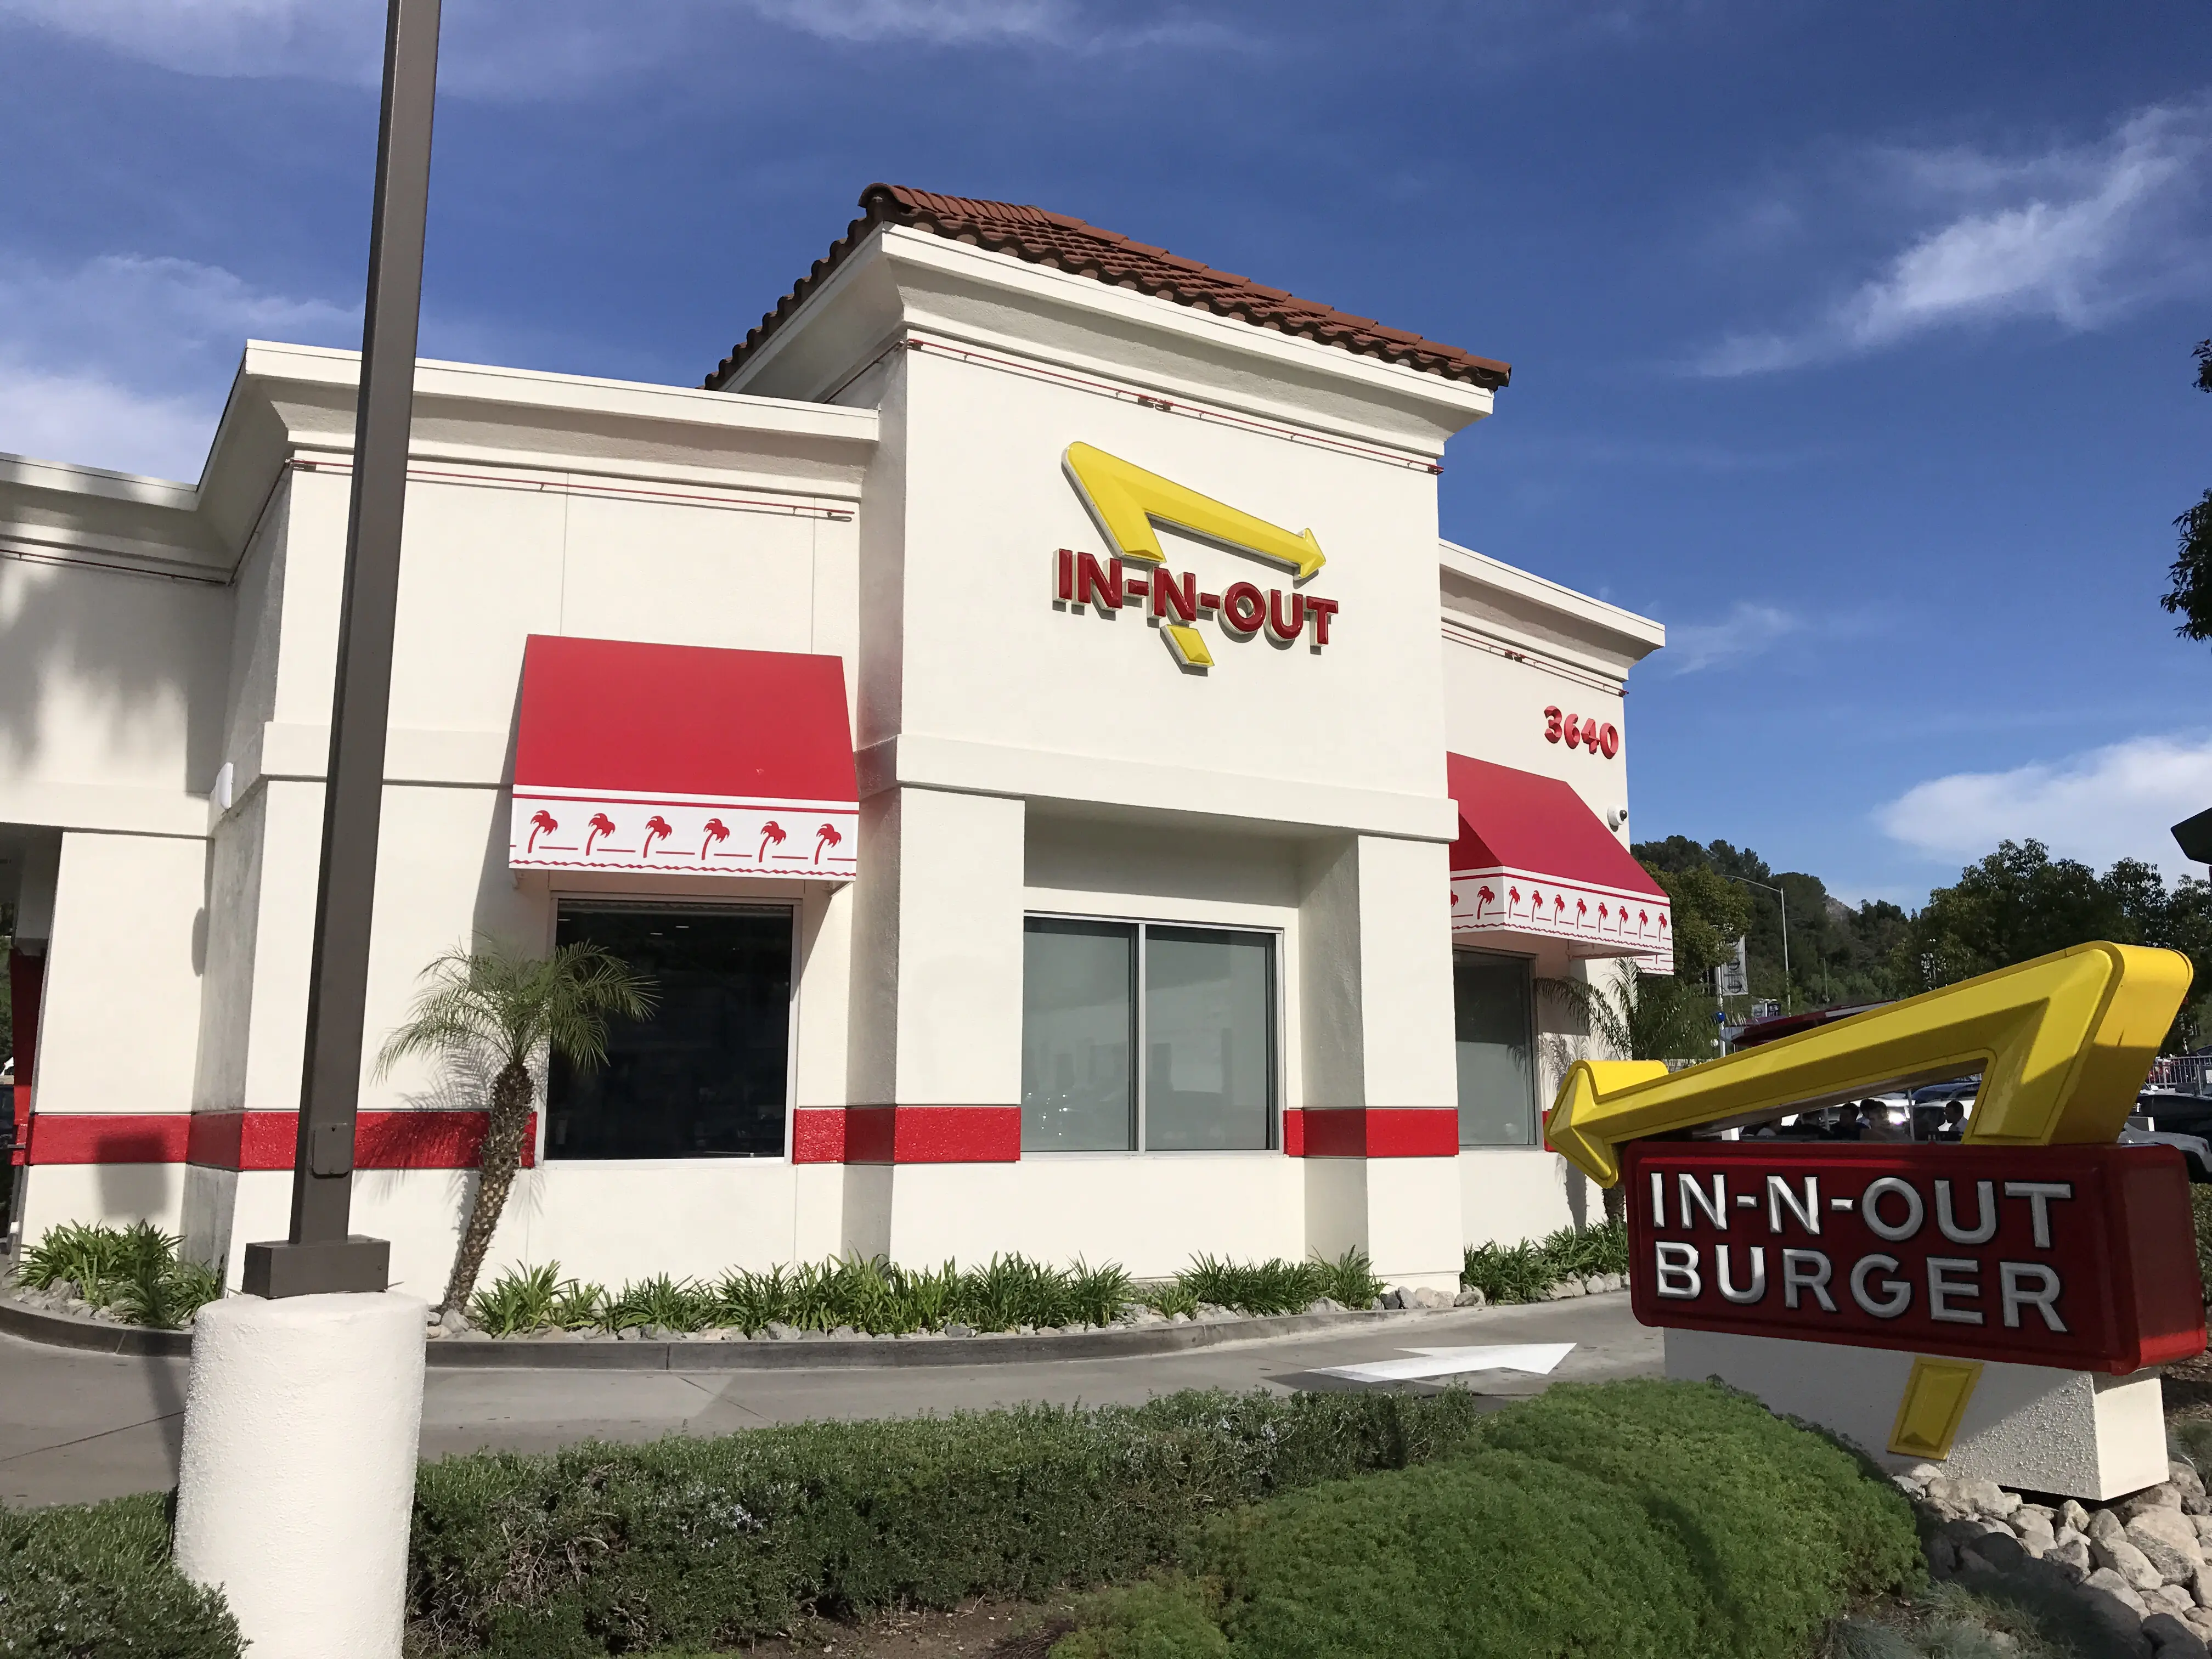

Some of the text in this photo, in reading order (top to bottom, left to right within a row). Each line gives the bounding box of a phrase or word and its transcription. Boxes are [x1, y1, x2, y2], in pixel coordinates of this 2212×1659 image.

[1053, 548, 1339, 646] IN-N-OUT
[1544, 706, 1619, 759] 3640
[1650, 1172, 2072, 1249] IN-N-OUT
[1655, 1241, 2068, 1333] BURGER
